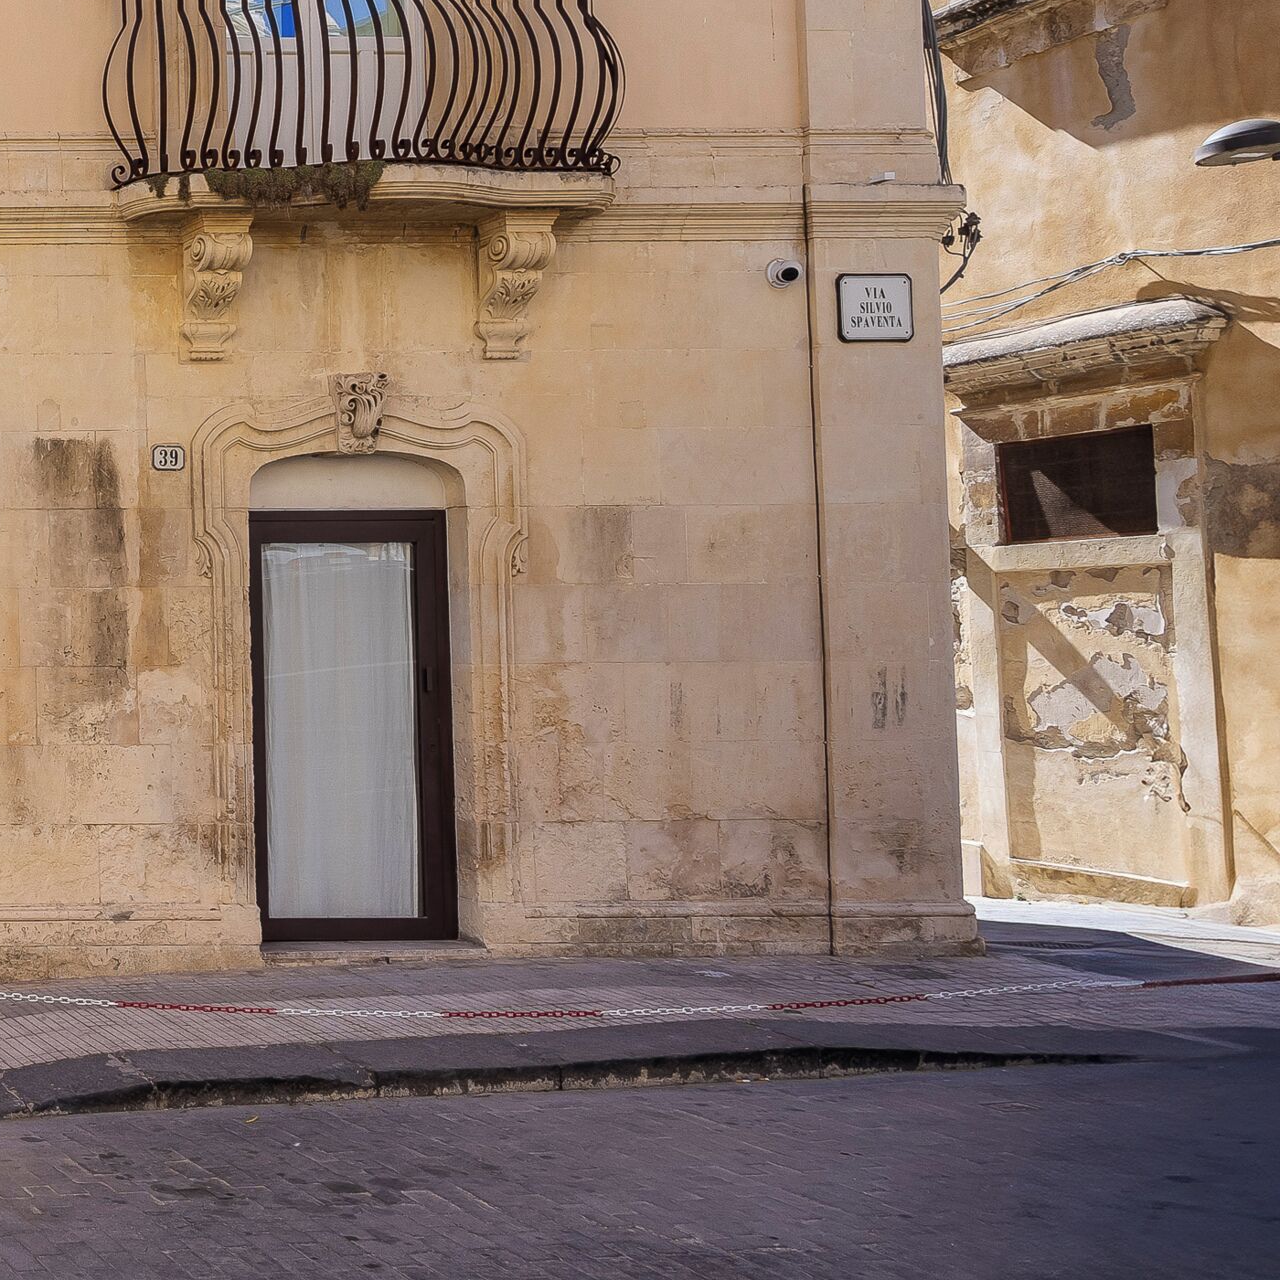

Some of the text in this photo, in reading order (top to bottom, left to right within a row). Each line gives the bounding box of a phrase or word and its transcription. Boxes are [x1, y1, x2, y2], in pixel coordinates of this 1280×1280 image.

[865, 287, 886, 299] VIA
[860, 302, 892, 314] SILVIO
[850, 315, 902, 328] SPAVENTA
[159, 449, 178, 467] 39
